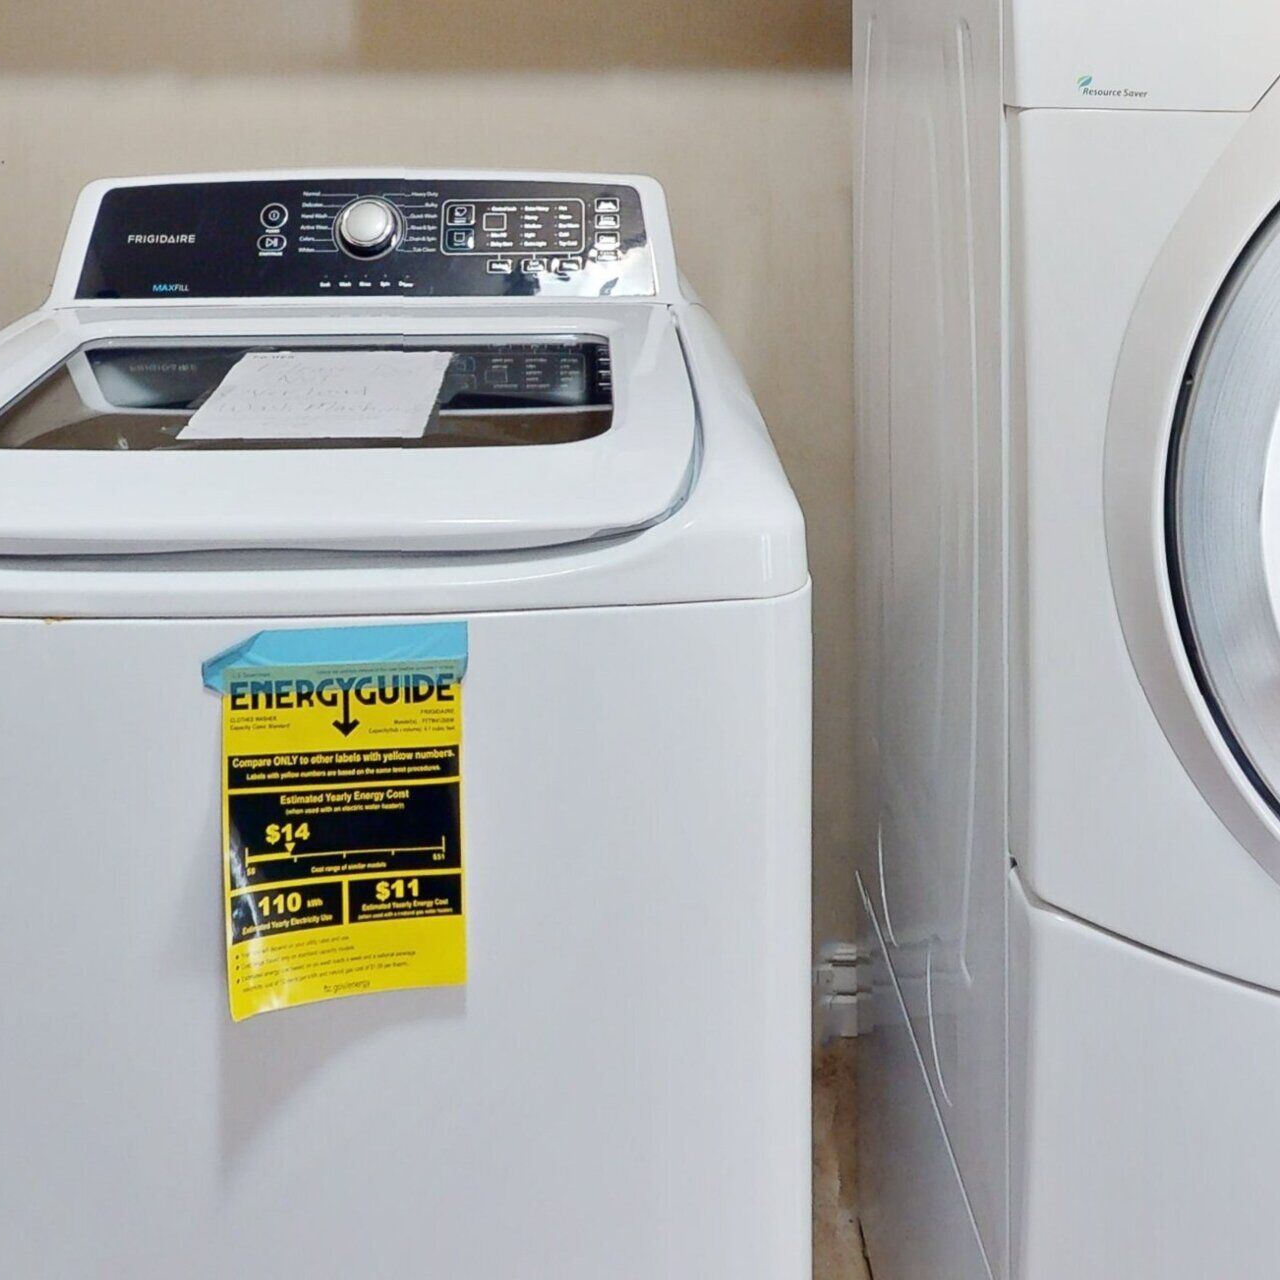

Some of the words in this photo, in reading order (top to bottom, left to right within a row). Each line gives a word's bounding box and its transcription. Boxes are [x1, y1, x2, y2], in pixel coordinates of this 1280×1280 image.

[1082, 87, 1122, 97] Resource
[1123, 89, 1148, 98] Saver
[127, 234, 196, 244] FRIGIDAIRE
[152, 283, 190, 292] MAXFILL
[230, 672, 455, 711] ENERGYGUIDE
[232, 757, 272, 769] Compare
[273, 754, 298, 767] ONLY
[299, 754, 309, 765] to
[310, 753, 334, 764] other
[334, 751, 361, 764] labels
[362, 750, 381, 762] with
[382, 749, 414, 763] yellow
[414, 747, 455, 760] numbers.
[246, 773, 266, 781] Labels
[267, 772, 280, 780] with
[280, 771, 300, 781] yellow
[300, 769, 326, 778] numbers
[326, 769, 337, 777] are
[337, 768, 356, 777] based
[356, 768, 365, 776] on
[365, 767, 375, 775] the
[280, 793, 324, 806] Estimated
[325, 791, 352, 804] Yearly
[353, 789, 384, 802] Energy
[385, 788, 410, 800] Cost
[285, 807, 304, 816] (when
[304, 806, 320, 815] used
[320, 805, 333, 813] with
[342, 803, 364, 812] electric
[364, 802, 380, 811] water
[265, 822, 311, 846] $14
[311, 865, 324, 874] Cost
[324, 865, 340, 874] range
[366, 860, 387, 870] models
[376, 878, 419, 902] $11
[258, 891, 302, 917] 110
[362, 902, 391, 912] Estimated
[392, 900, 412, 909] Yearly
[412, 899, 434, 908] Energy
[434, 898, 449, 906] Cost
[242, 921, 271, 936] Estimated
[271, 919, 290, 929] Yearly
[290, 915, 320, 926] Electricity
[320, 913, 334, 922] Use
